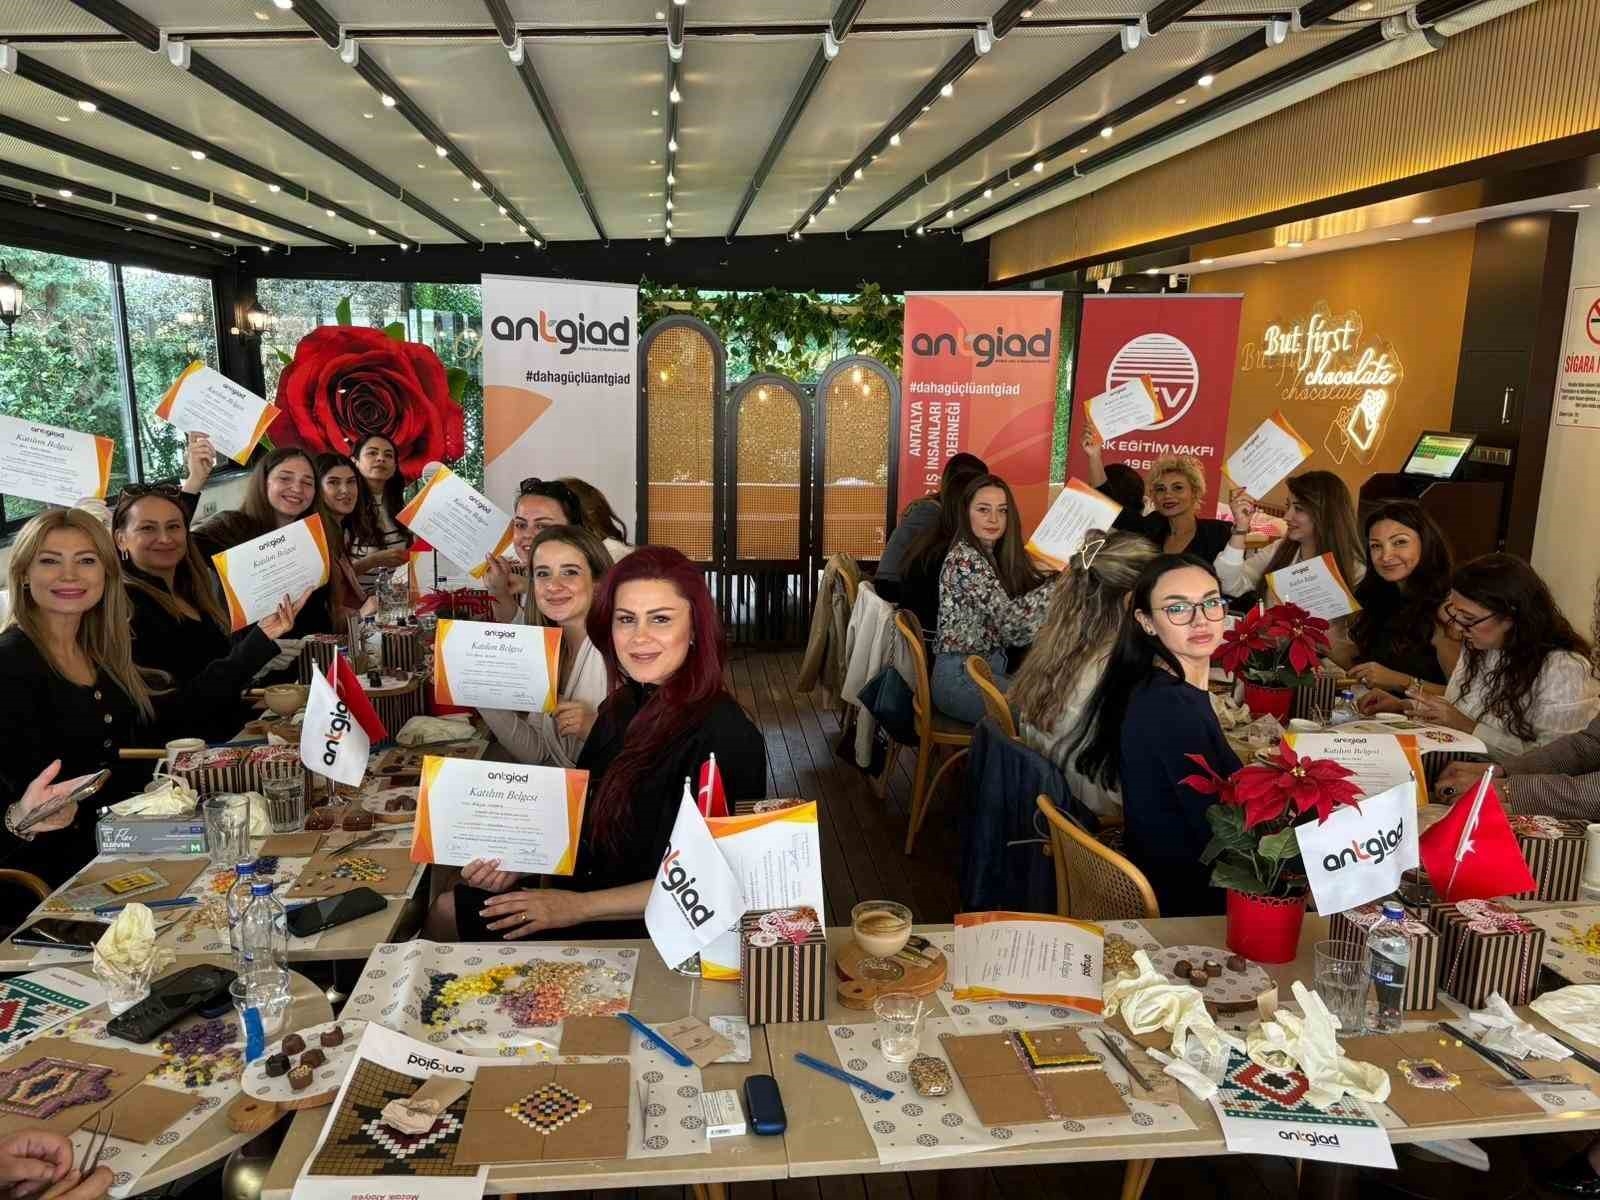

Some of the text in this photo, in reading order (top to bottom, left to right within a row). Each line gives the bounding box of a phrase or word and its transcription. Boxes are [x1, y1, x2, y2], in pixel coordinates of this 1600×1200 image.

[490, 310, 630, 355] antgiad
[911, 326, 1052, 368] antgiad
[1264, 325, 1301, 356] But
[1298, 314, 1356, 371] first
[525, 370, 631, 386] #dahagüçlüantgiad
[1305, 347, 1397, 385] chocolate
[1565, 352, 1595, 374] SİGARA
[909, 381, 1020, 397] #dahagüçlüantgiad
[909, 401, 923, 457] ANTALYA
[924, 401, 942, 470] İNSANLARI
[1118, 440, 1169, 454] EĞİTİM
[1171, 445, 1214, 456] VAKFI
[923, 473, 942, 485] İŞ
[1123, 458, 1152, 470] 196
[323, 700, 351, 766] antgia
[191, 844, 201, 852] M
